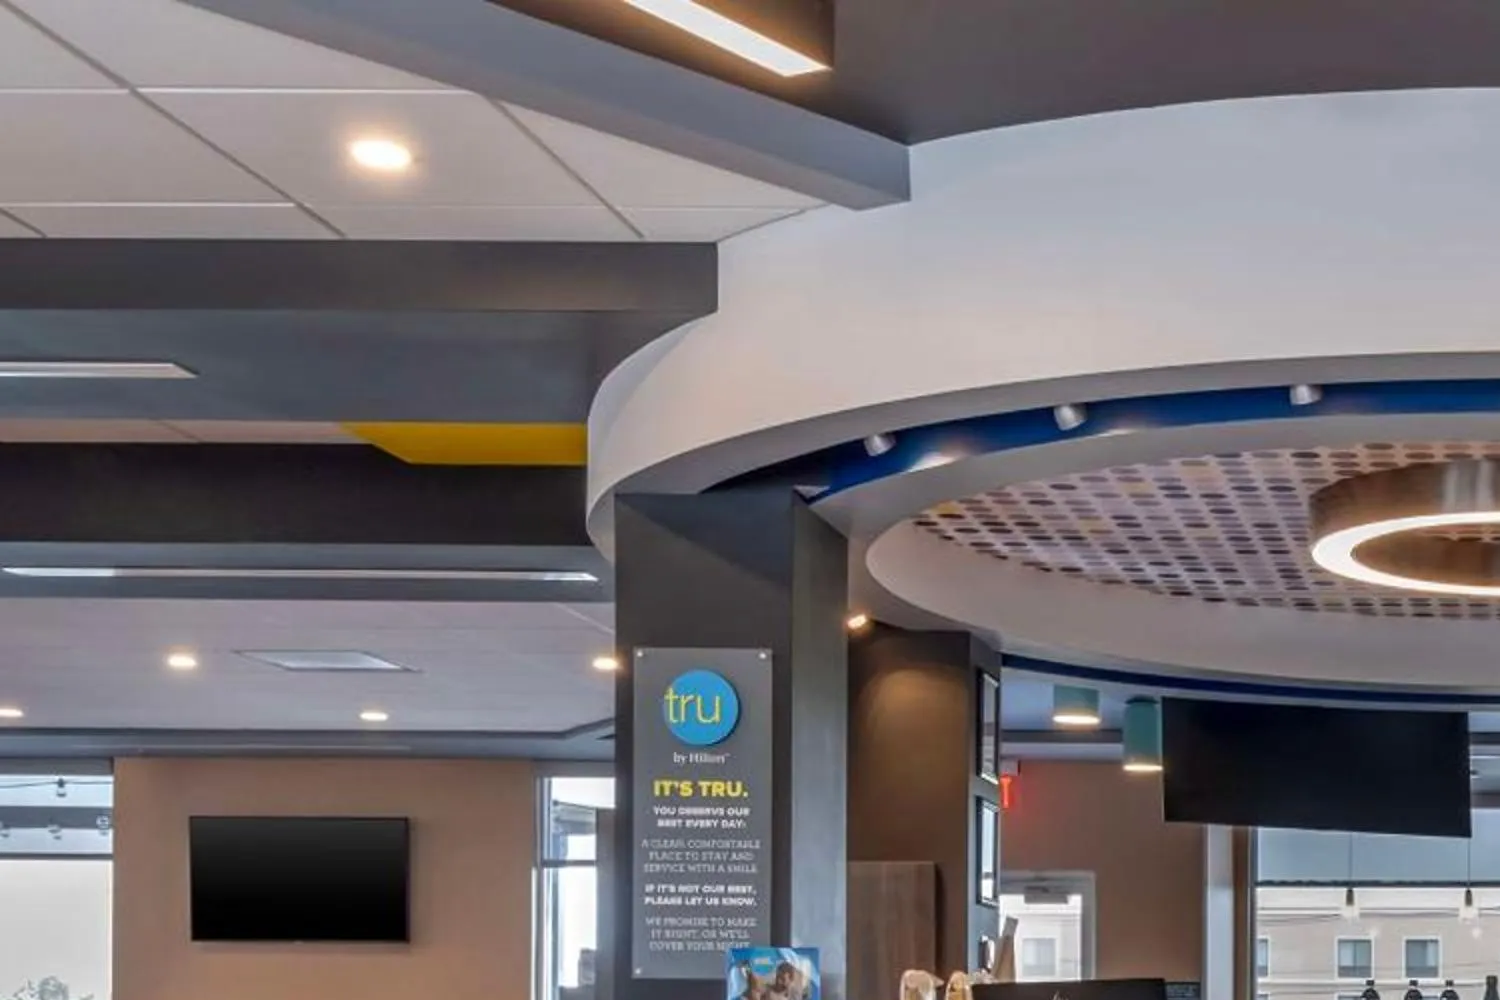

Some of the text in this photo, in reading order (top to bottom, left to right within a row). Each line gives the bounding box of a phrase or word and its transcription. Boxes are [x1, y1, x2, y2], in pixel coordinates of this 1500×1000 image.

[664, 686, 721, 724] tru
[673, 751, 688, 766] by
[653, 780, 748, 797] IT'S TRU.
[653, 806, 676, 815] YOU
[685, 819, 718, 828] EVERY
